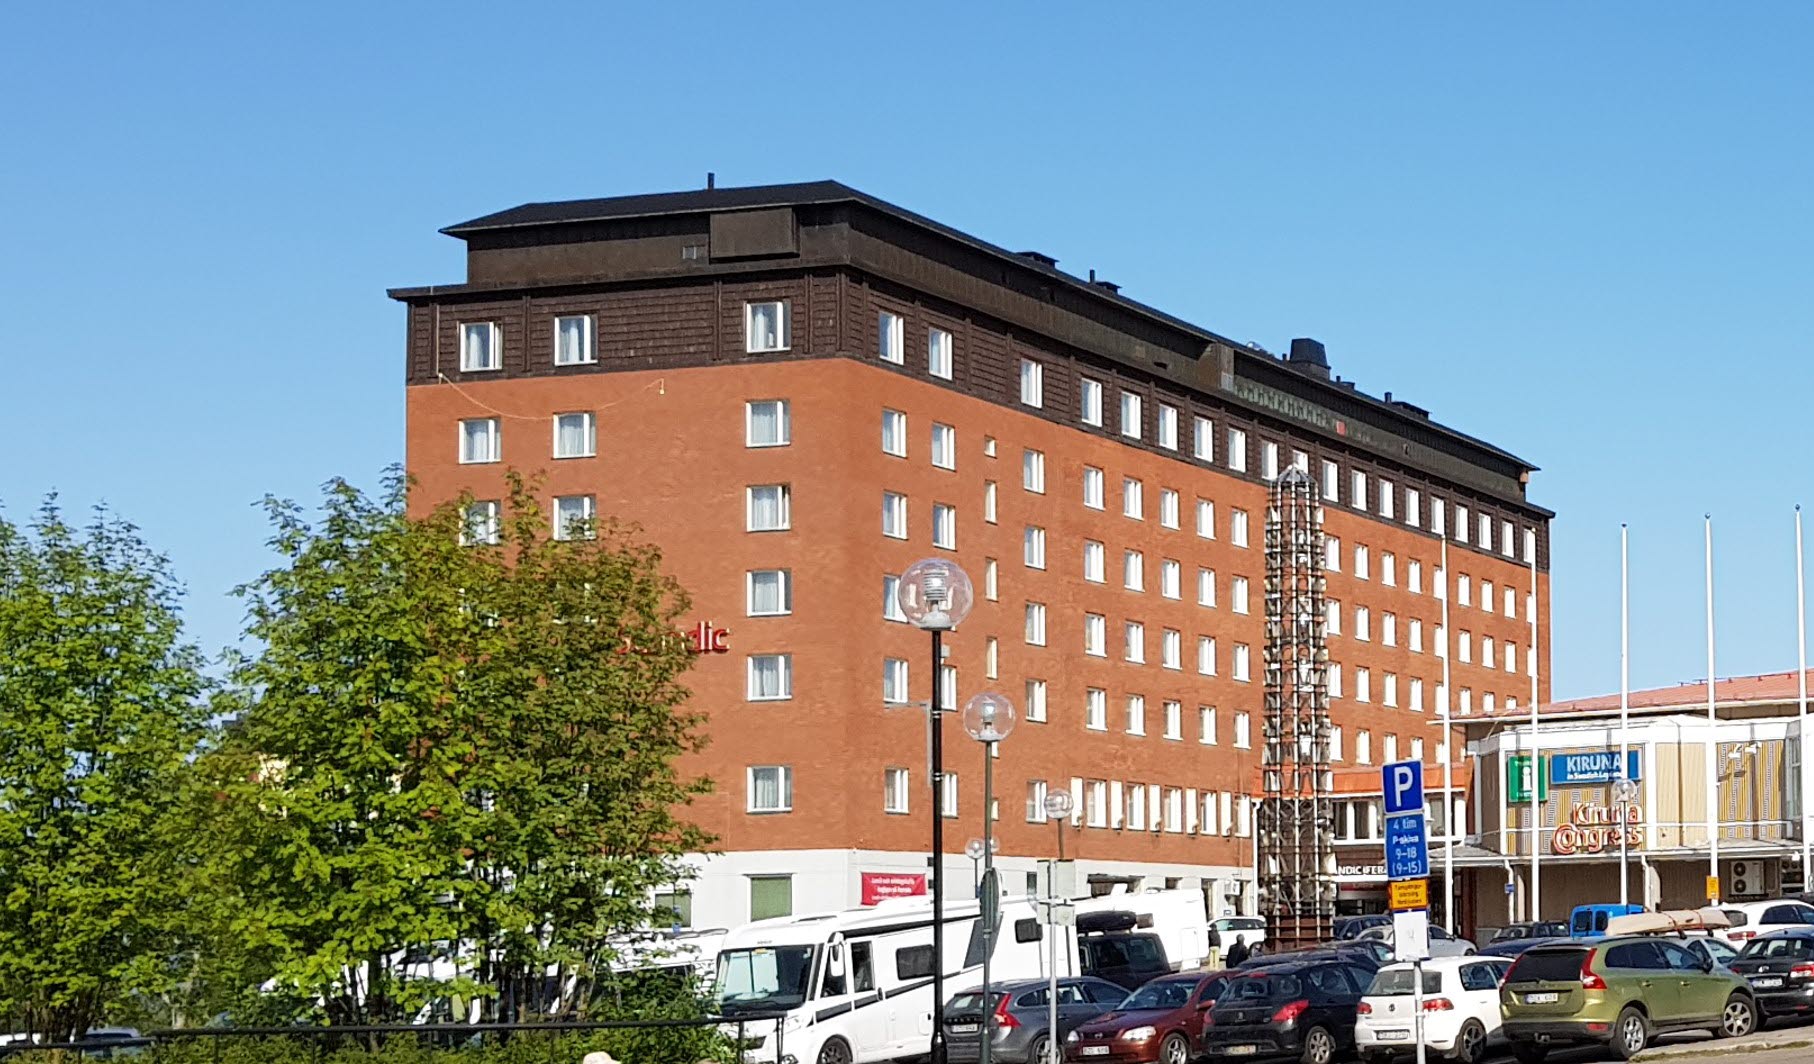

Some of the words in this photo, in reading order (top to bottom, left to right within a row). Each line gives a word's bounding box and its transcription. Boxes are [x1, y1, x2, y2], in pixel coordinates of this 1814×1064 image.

[1566, 754, 1622, 772] KIRUNA
[1394, 766, 1413, 808] P
[1393, 818, 1399, 830] 4
[1395, 846, 1417, 860] 9-18
[1392, 860, 1422, 876] (9-15)
